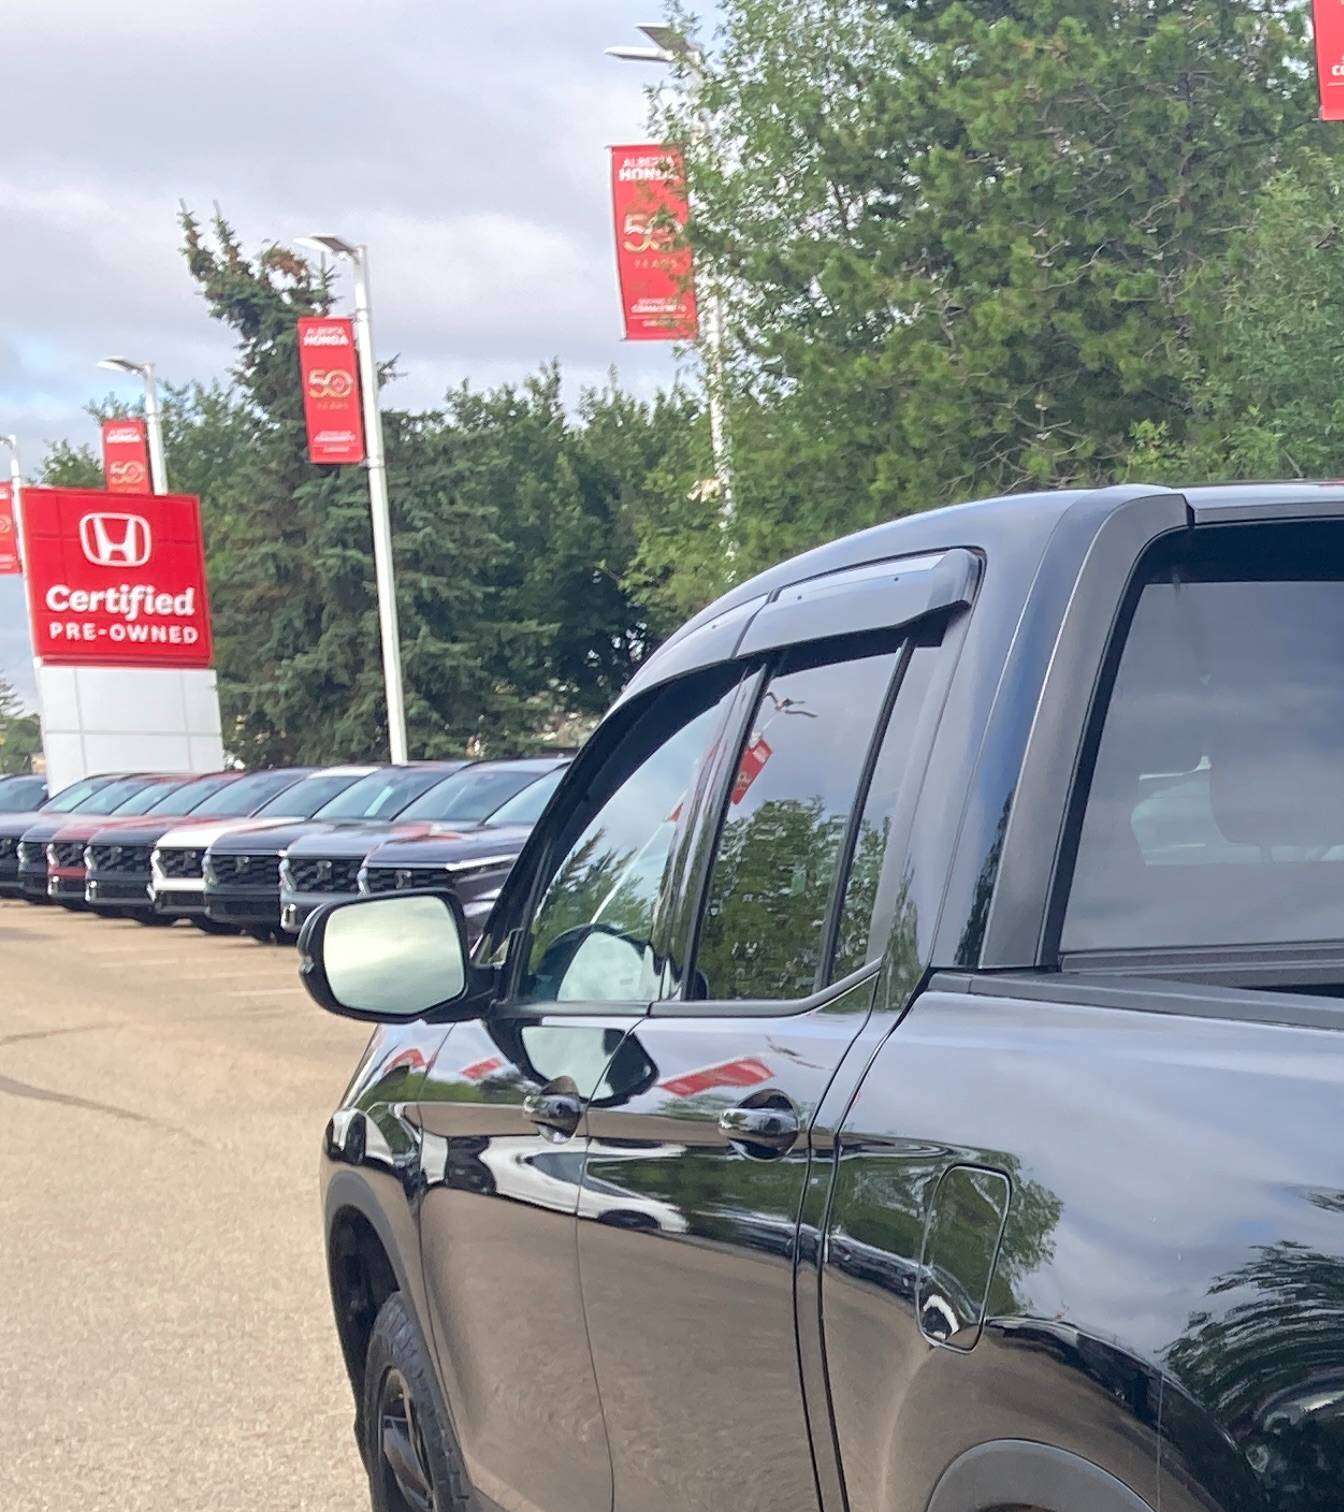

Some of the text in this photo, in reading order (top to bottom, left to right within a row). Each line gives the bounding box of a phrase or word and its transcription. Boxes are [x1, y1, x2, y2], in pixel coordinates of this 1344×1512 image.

[308, 368, 353, 399] 50
[46, 584, 195, 621] Certified
[49, 622, 199, 644] PRE-OWNED
